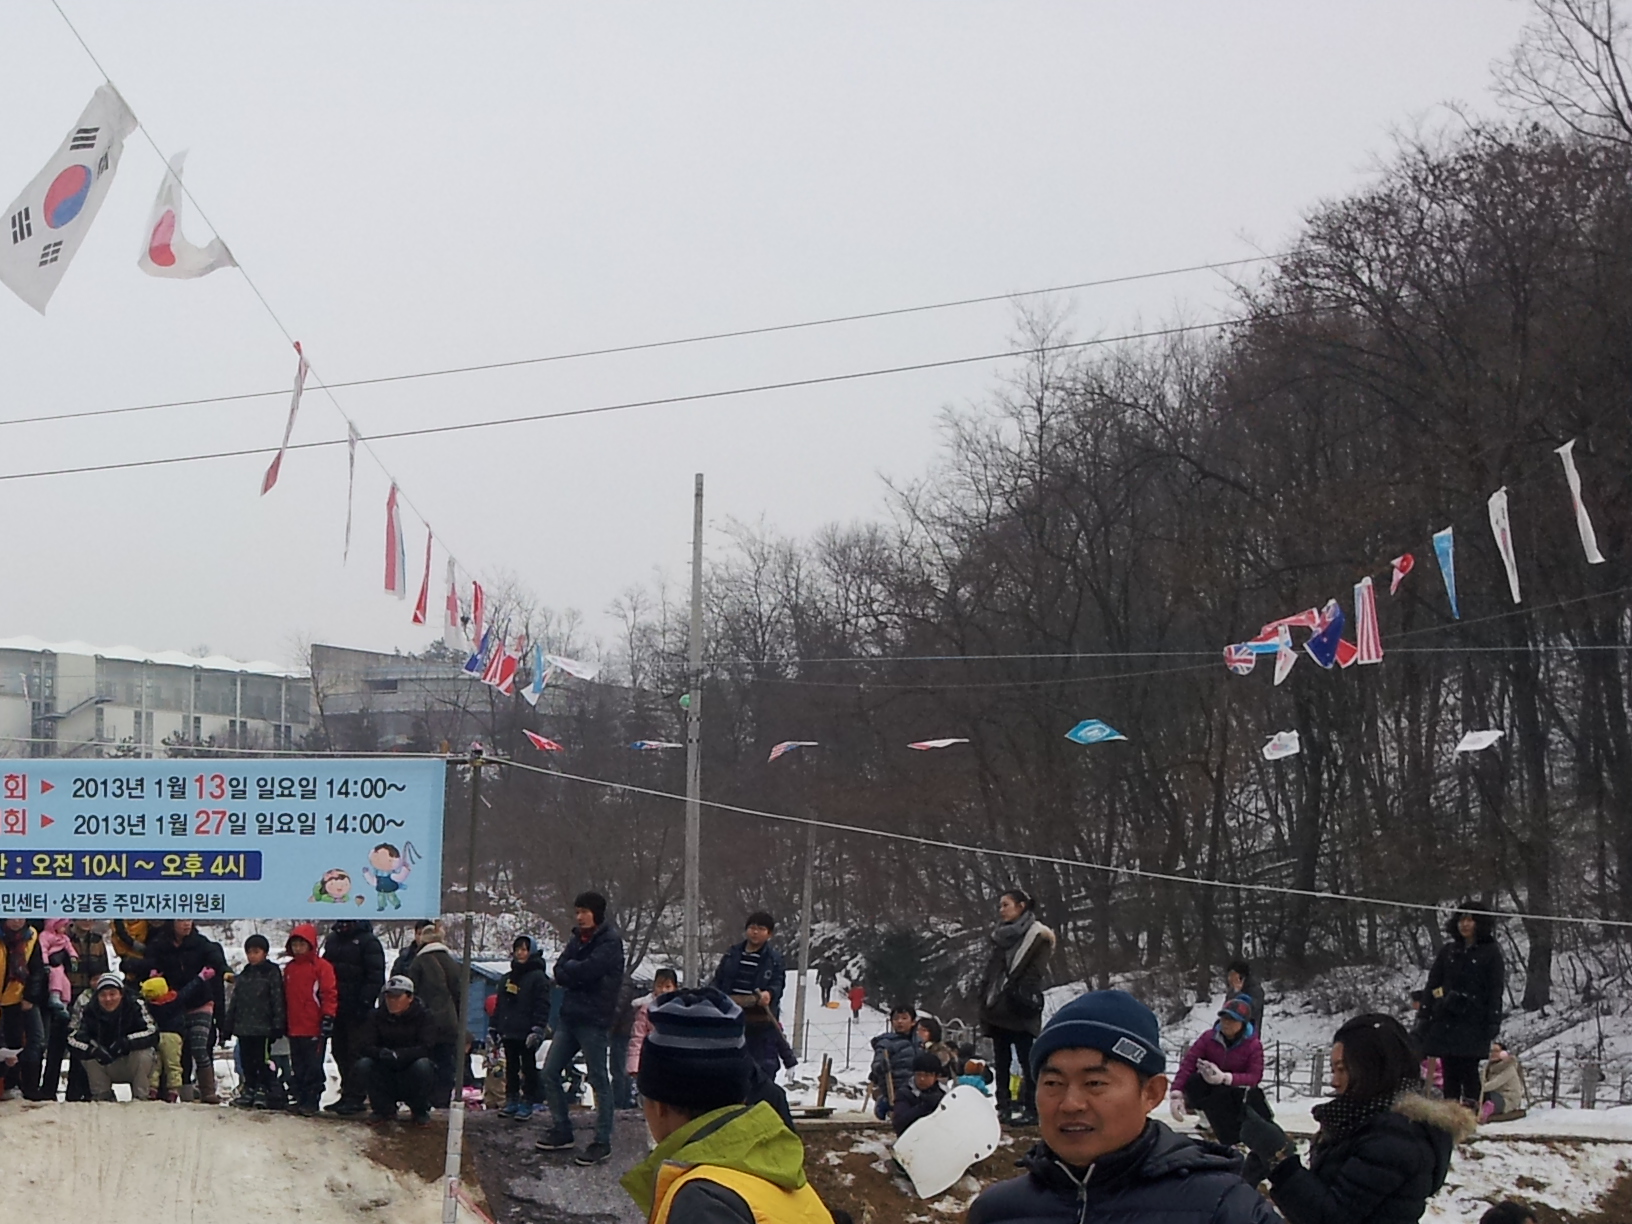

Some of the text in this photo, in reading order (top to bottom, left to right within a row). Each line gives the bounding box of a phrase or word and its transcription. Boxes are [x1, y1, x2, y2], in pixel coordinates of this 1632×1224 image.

[72, 776, 145, 799] 2013년
[154, 776, 187, 800] 1월
[256, 776, 317, 800] 일요일
[326, 777, 407, 799] 14:00~
[73, 813, 146, 836] 2013년
[155, 812, 188, 836] 1월
[255, 812, 316, 836] 일요일
[325, 813, 405, 835] 14:00~
[30, 853, 74, 877] 오전
[81, 853, 128, 878] 10시
[160, 853, 205, 878] 오후
[210, 853, 246, 878] 4시
[60, 892, 109, 913] 상갈동
[112, 892, 226, 914] 주민자치위원회
